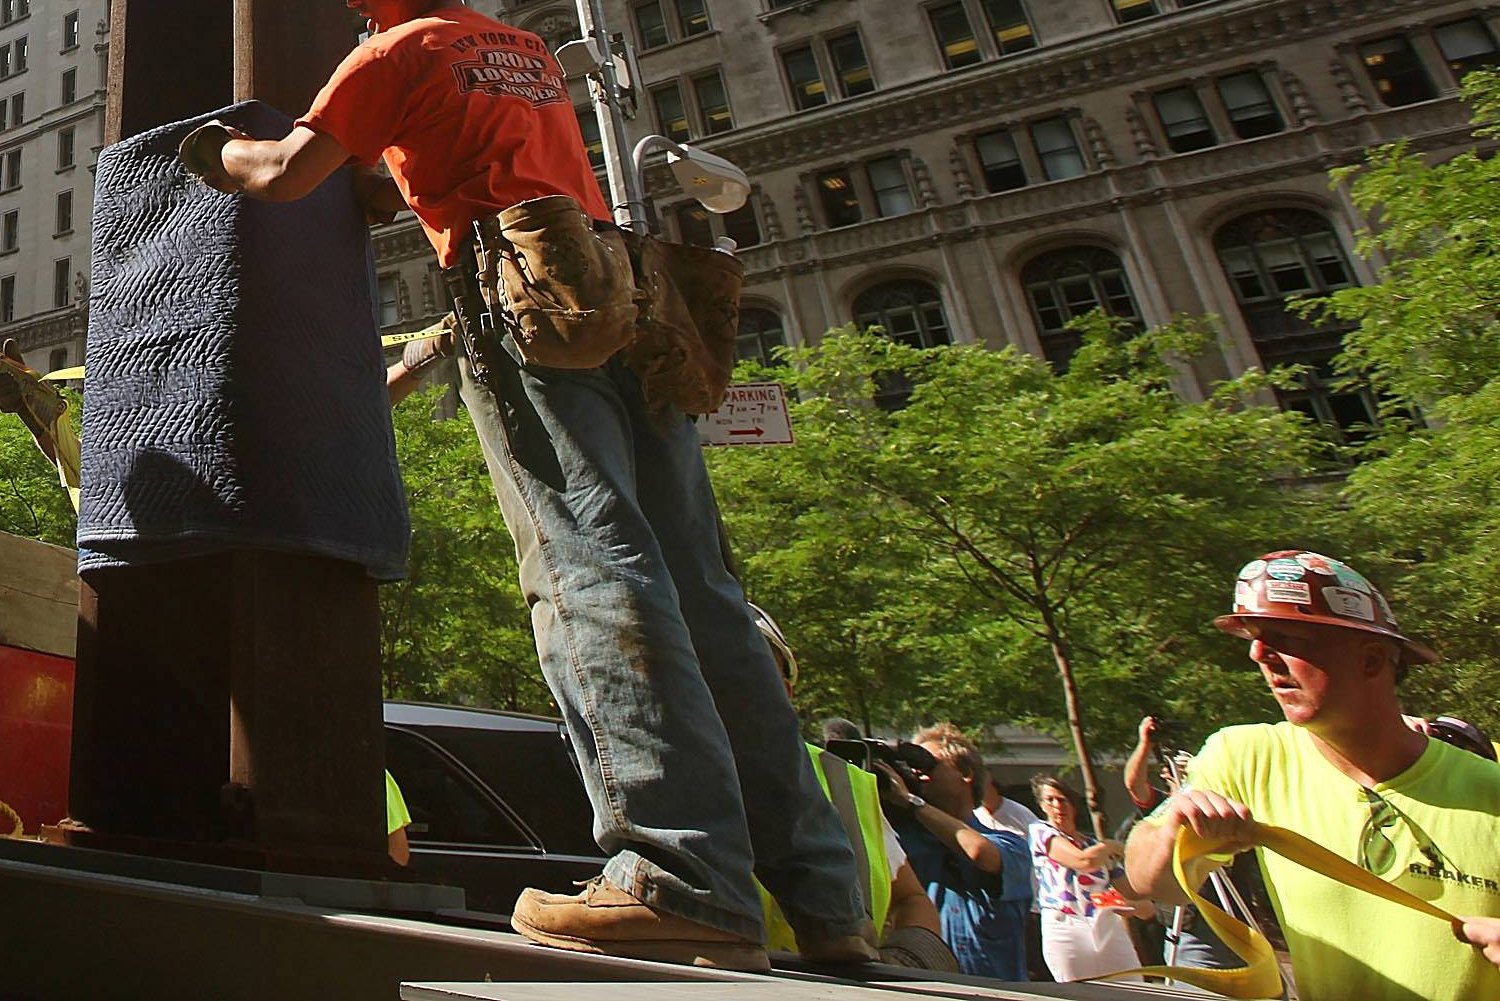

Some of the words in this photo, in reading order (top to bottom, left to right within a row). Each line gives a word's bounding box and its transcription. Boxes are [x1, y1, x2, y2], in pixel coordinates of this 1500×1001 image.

[451, 34, 478, 53] NEW
[478, 32, 519, 47] YORK
[486, 51, 543, 69] IRON
[472, 68, 540, 84] LOCAL
